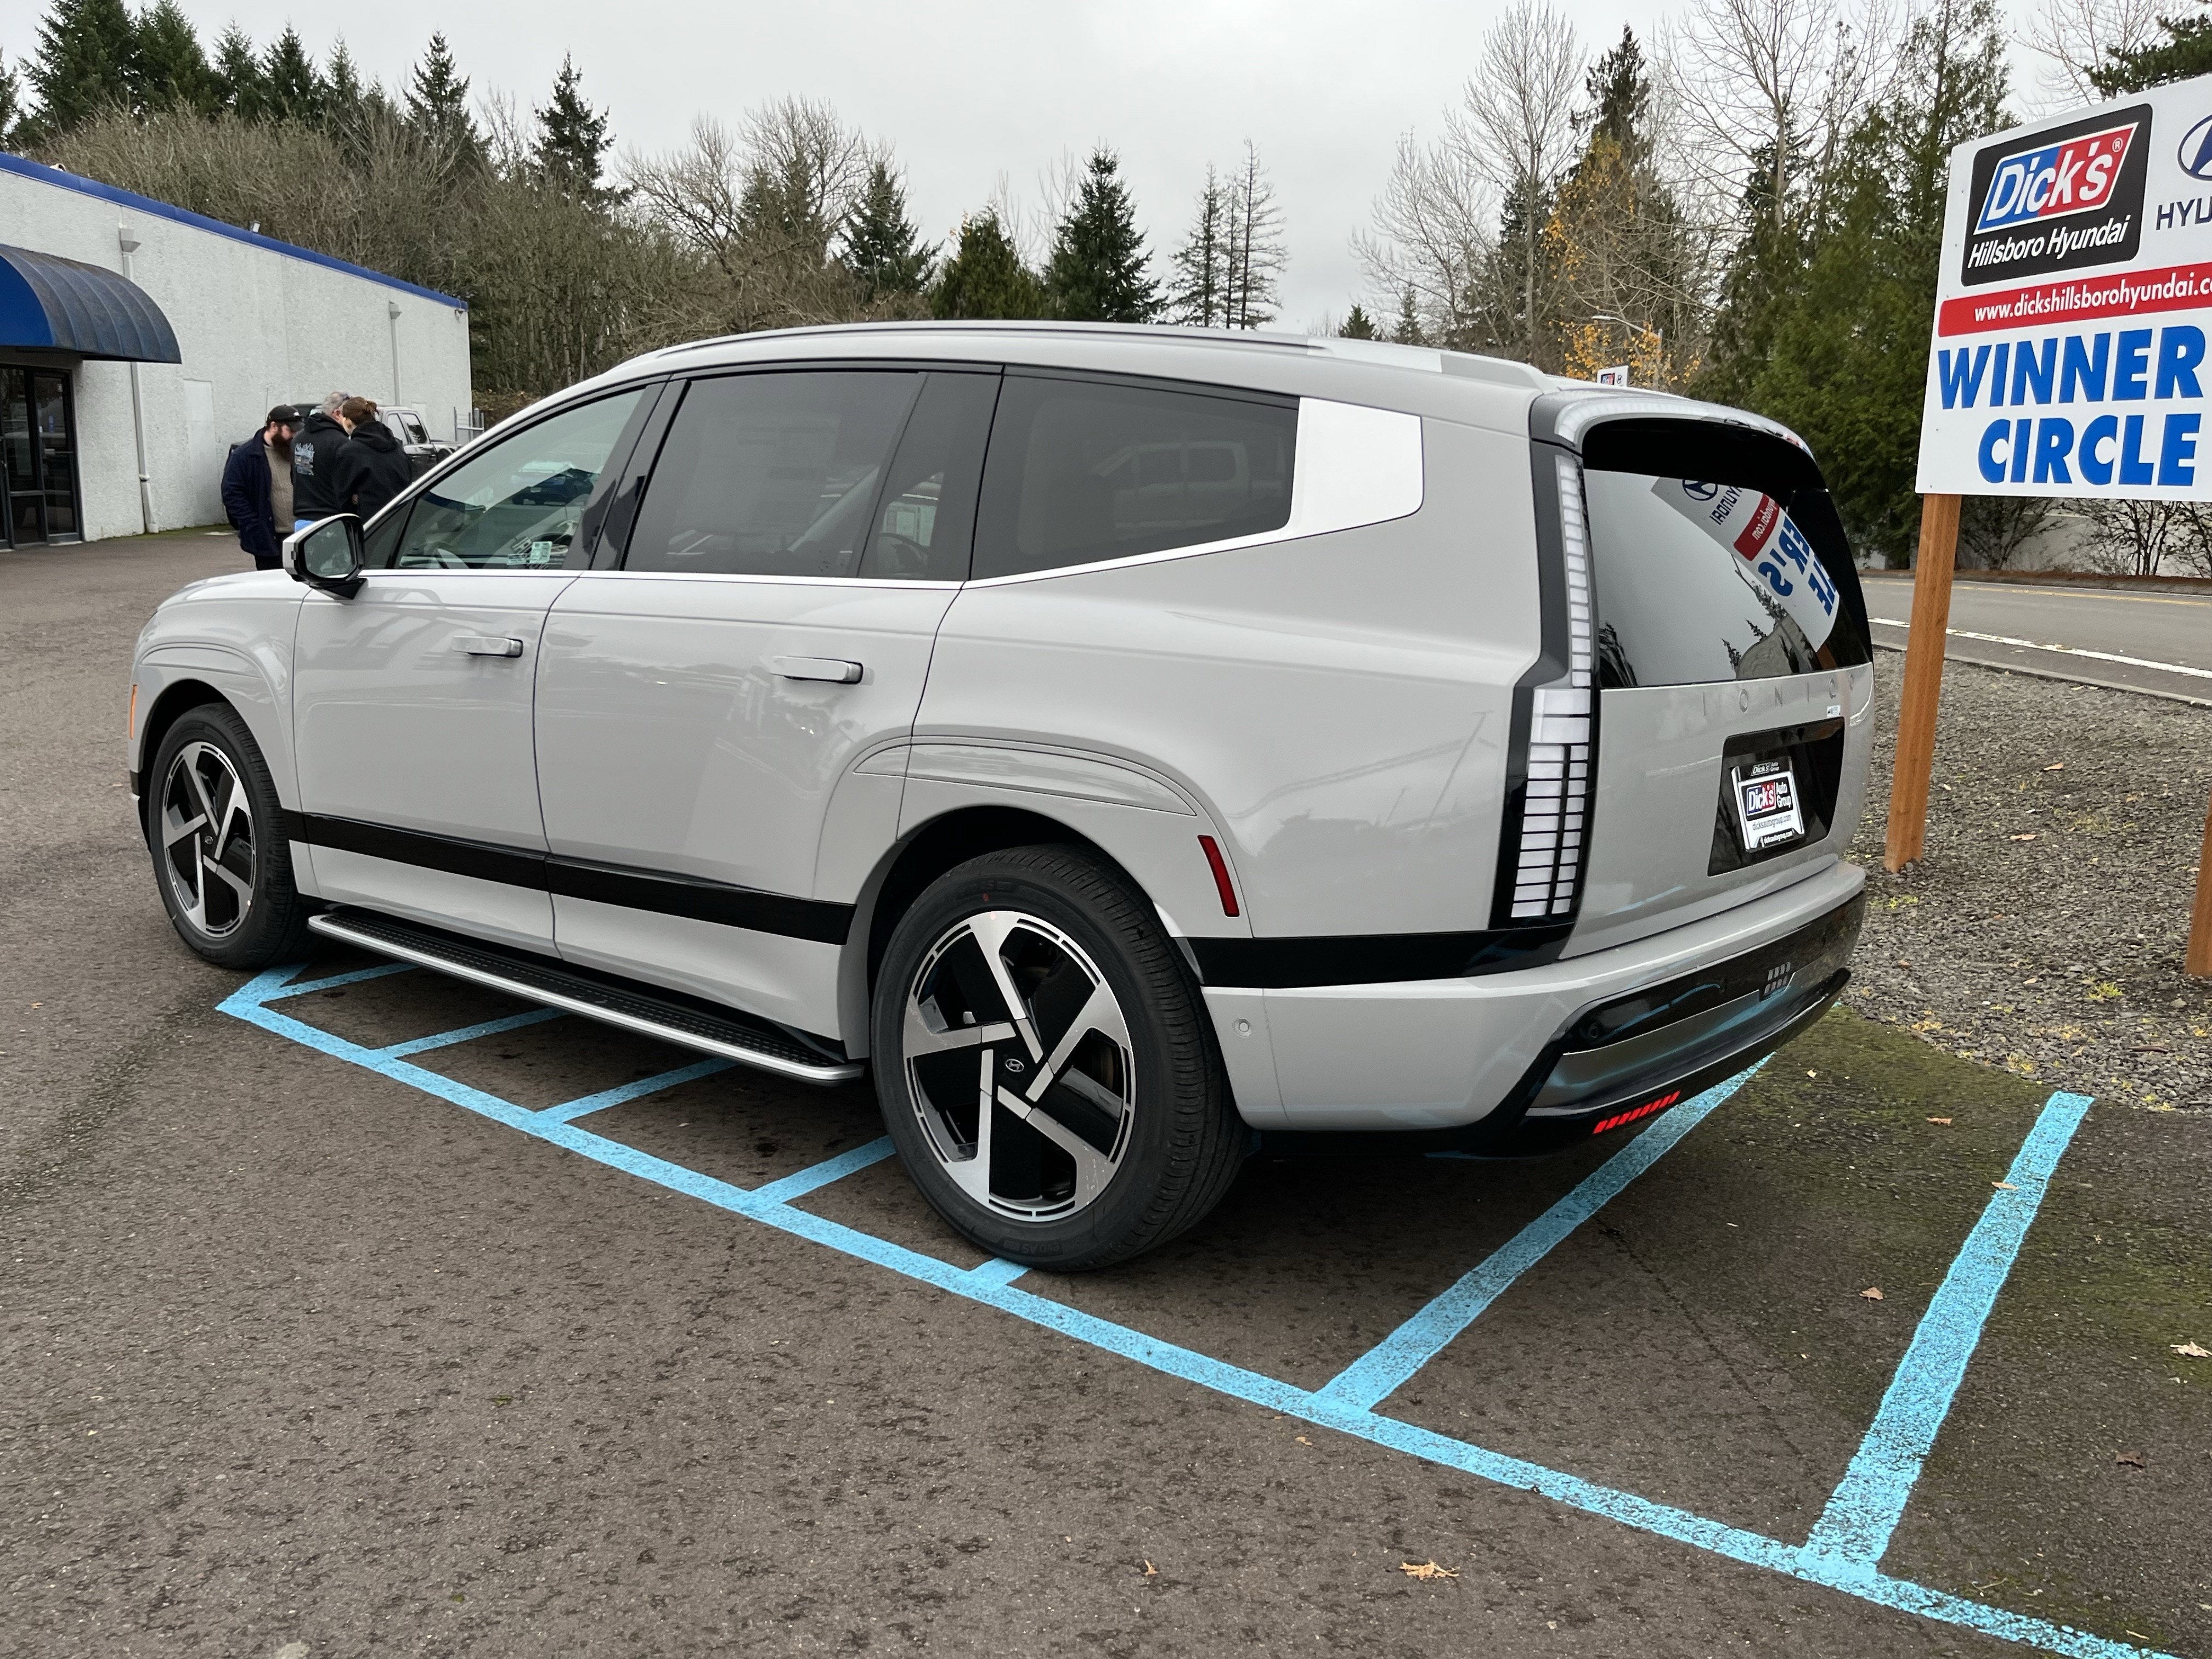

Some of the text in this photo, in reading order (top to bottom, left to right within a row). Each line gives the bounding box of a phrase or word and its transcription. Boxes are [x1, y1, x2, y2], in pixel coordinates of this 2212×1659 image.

[1986, 141, 2112, 221] Dick's
[1967, 215, 2131, 269] Hillsboro Hyundai
[1974, 272, 2212, 322] www.dickshillsborohyundai.c
[1938, 325, 2206, 410] WINNER
[1978, 413, 2202, 486] CIRCLE
[1702, 678, 1836, 716] IONIQ
[1748, 784, 1774, 811] Dick's
[1776, 782, 1787, 795] Auto
[1776, 795, 1792, 809] Group
